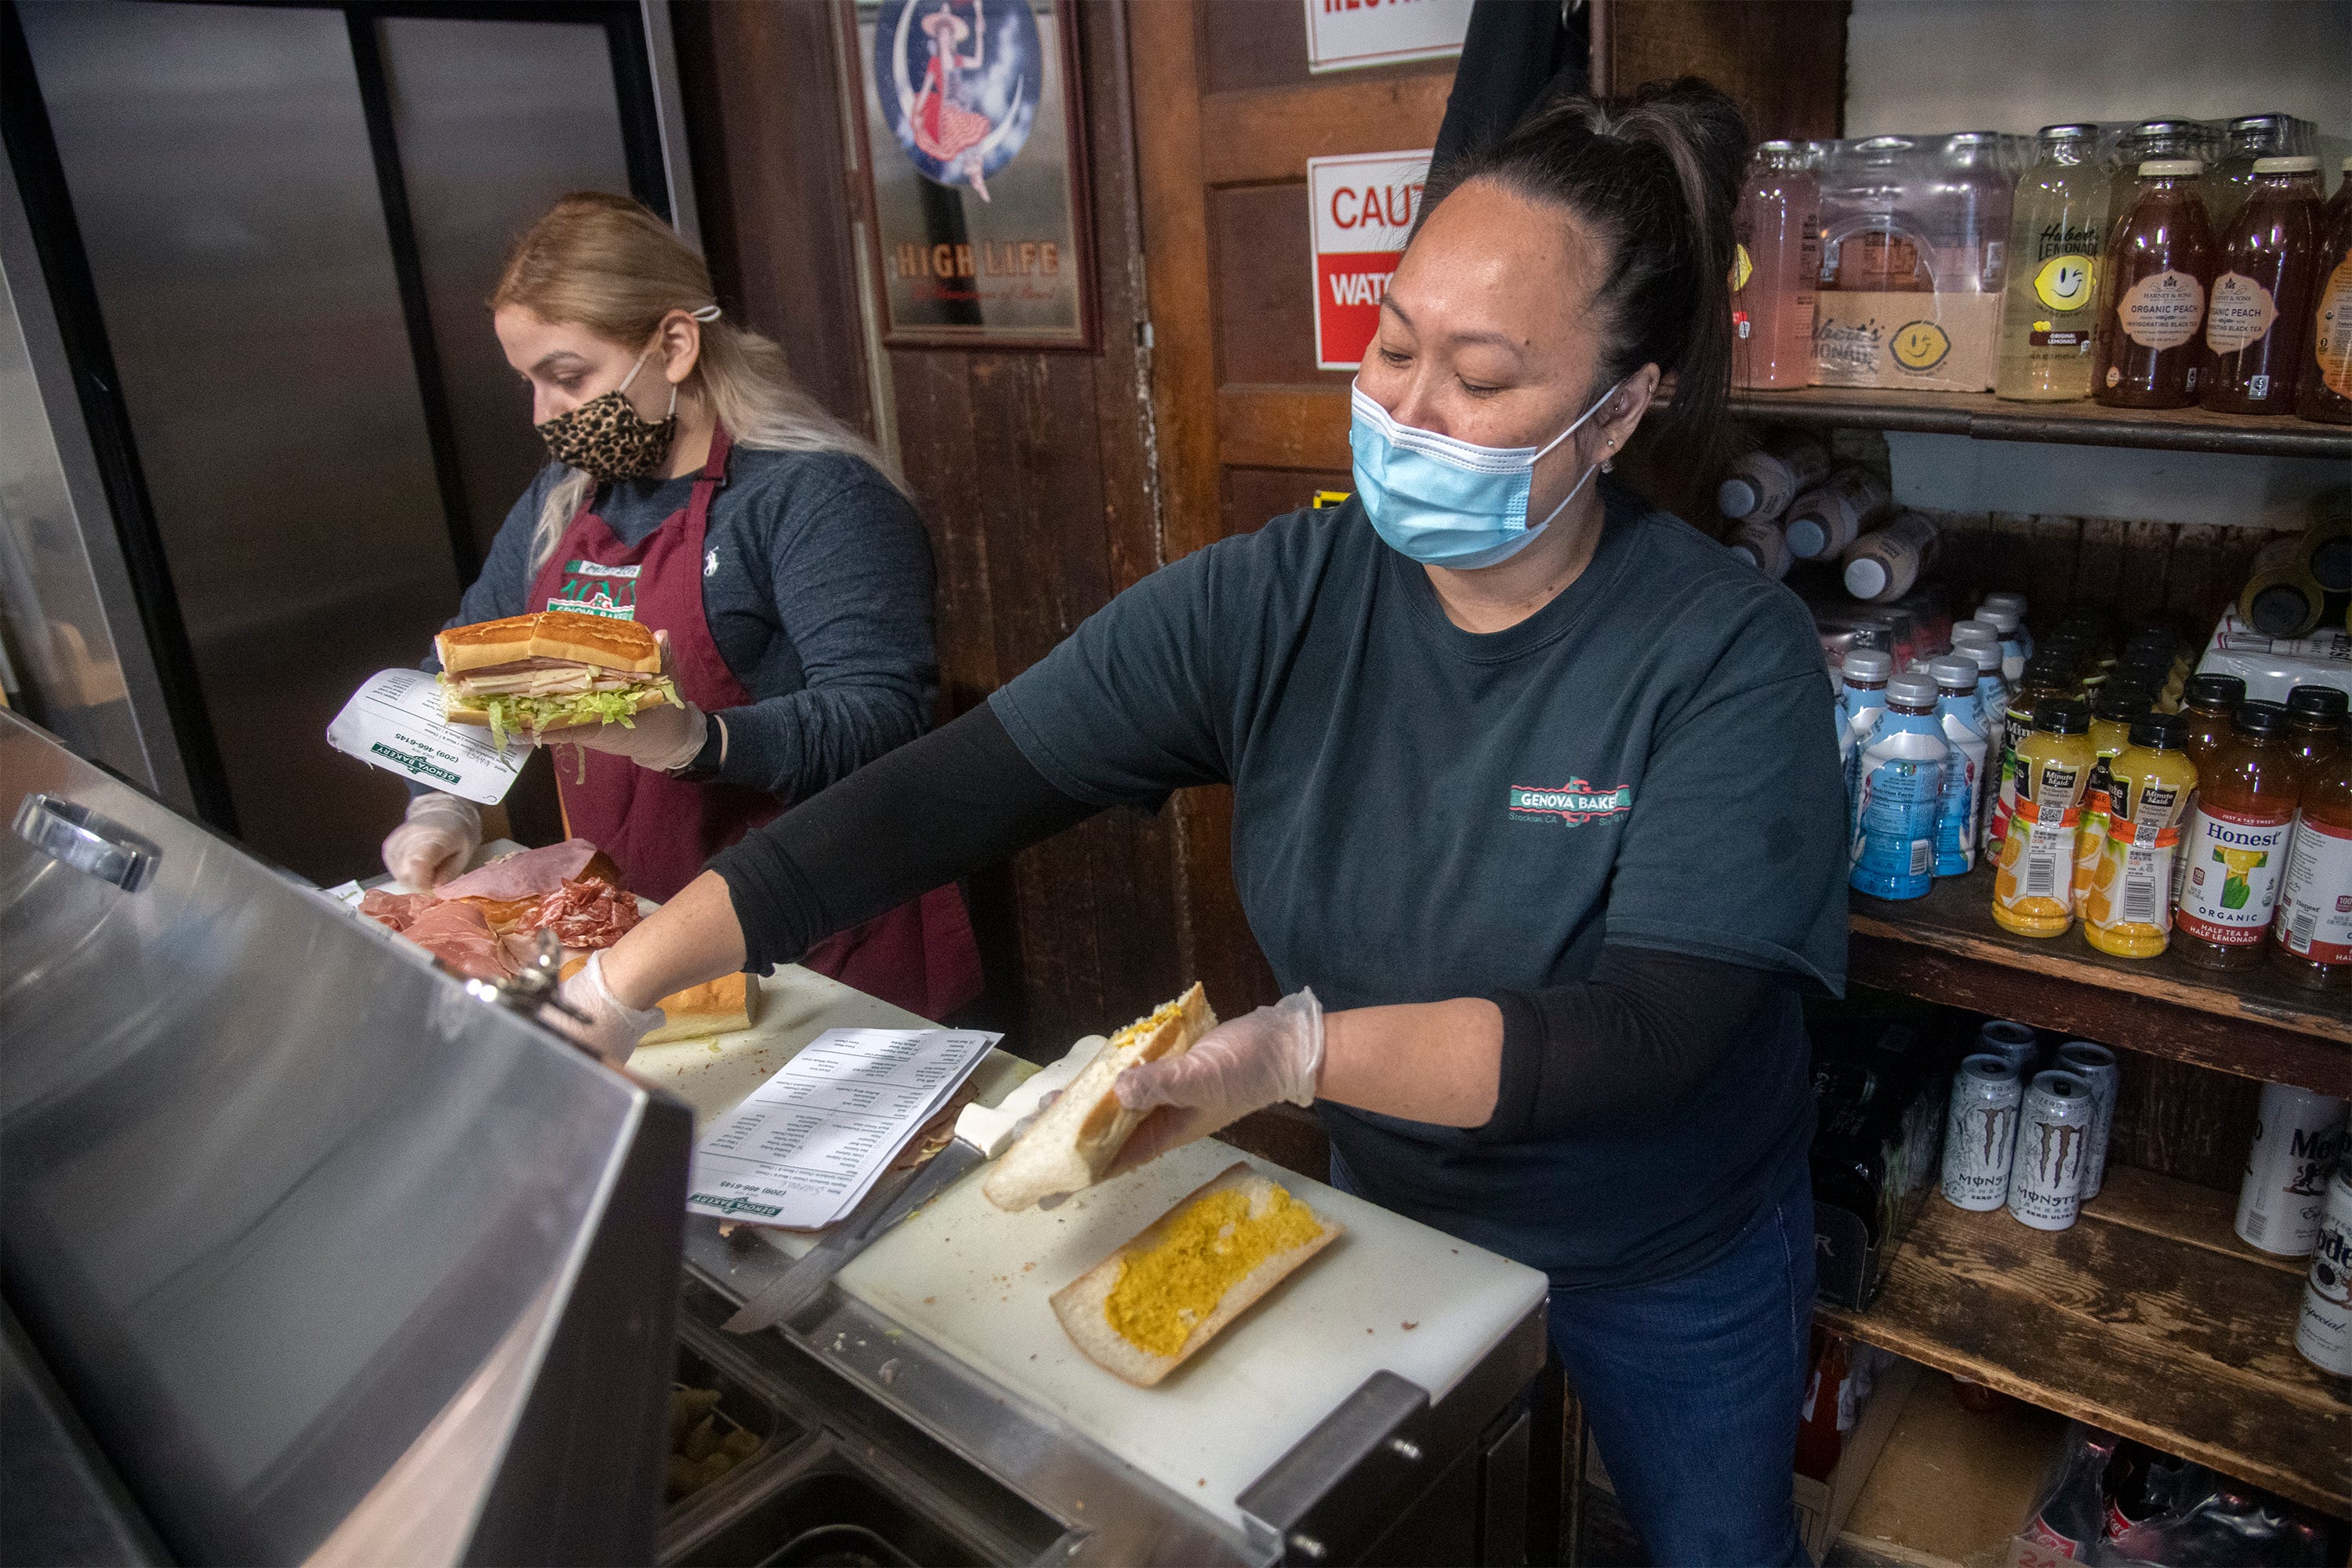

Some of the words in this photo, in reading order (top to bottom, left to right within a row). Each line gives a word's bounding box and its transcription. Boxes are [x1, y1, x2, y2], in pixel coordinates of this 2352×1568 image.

[896, 244, 975, 278] HIGH
[983, 241, 1060, 277] LIFE
[2131, 305, 2171, 314] ORGANIC
[2231, 308, 2262, 318] PEACH
[394, 732, 434, 754] 466-6145
[376, 745, 415, 765] BAKERY
[435, 749, 459, 764] (209)
[417, 761, 455, 781] GENOVA
[493, 764, 507, 773] Name
[2046, 771, 2074, 780] Minute
[1520, 793, 1574, 808] GENOVA
[1578, 793, 1619, 809] BAKE
[2146, 790, 2174, 799] Minute
[2147, 797, 2169, 805] Maid
[1544, 815, 1558, 823] CA
[2207, 822, 2282, 847] Honest
[2198, 906, 2257, 922] ORGANIC
[2190, 926, 2209, 938] HALF
[2212, 934, 2257, 943] LEMONADE
[2201, 924, 2223, 934] HALF
[2040, 1097, 2062, 1109] ZERO
[718, 1179, 762, 1192] 466-6145
[760, 1186, 788, 1197] (209)
[691, 1194, 735, 1207] BAKERY
[732, 1201, 777, 1215] GENOVA
